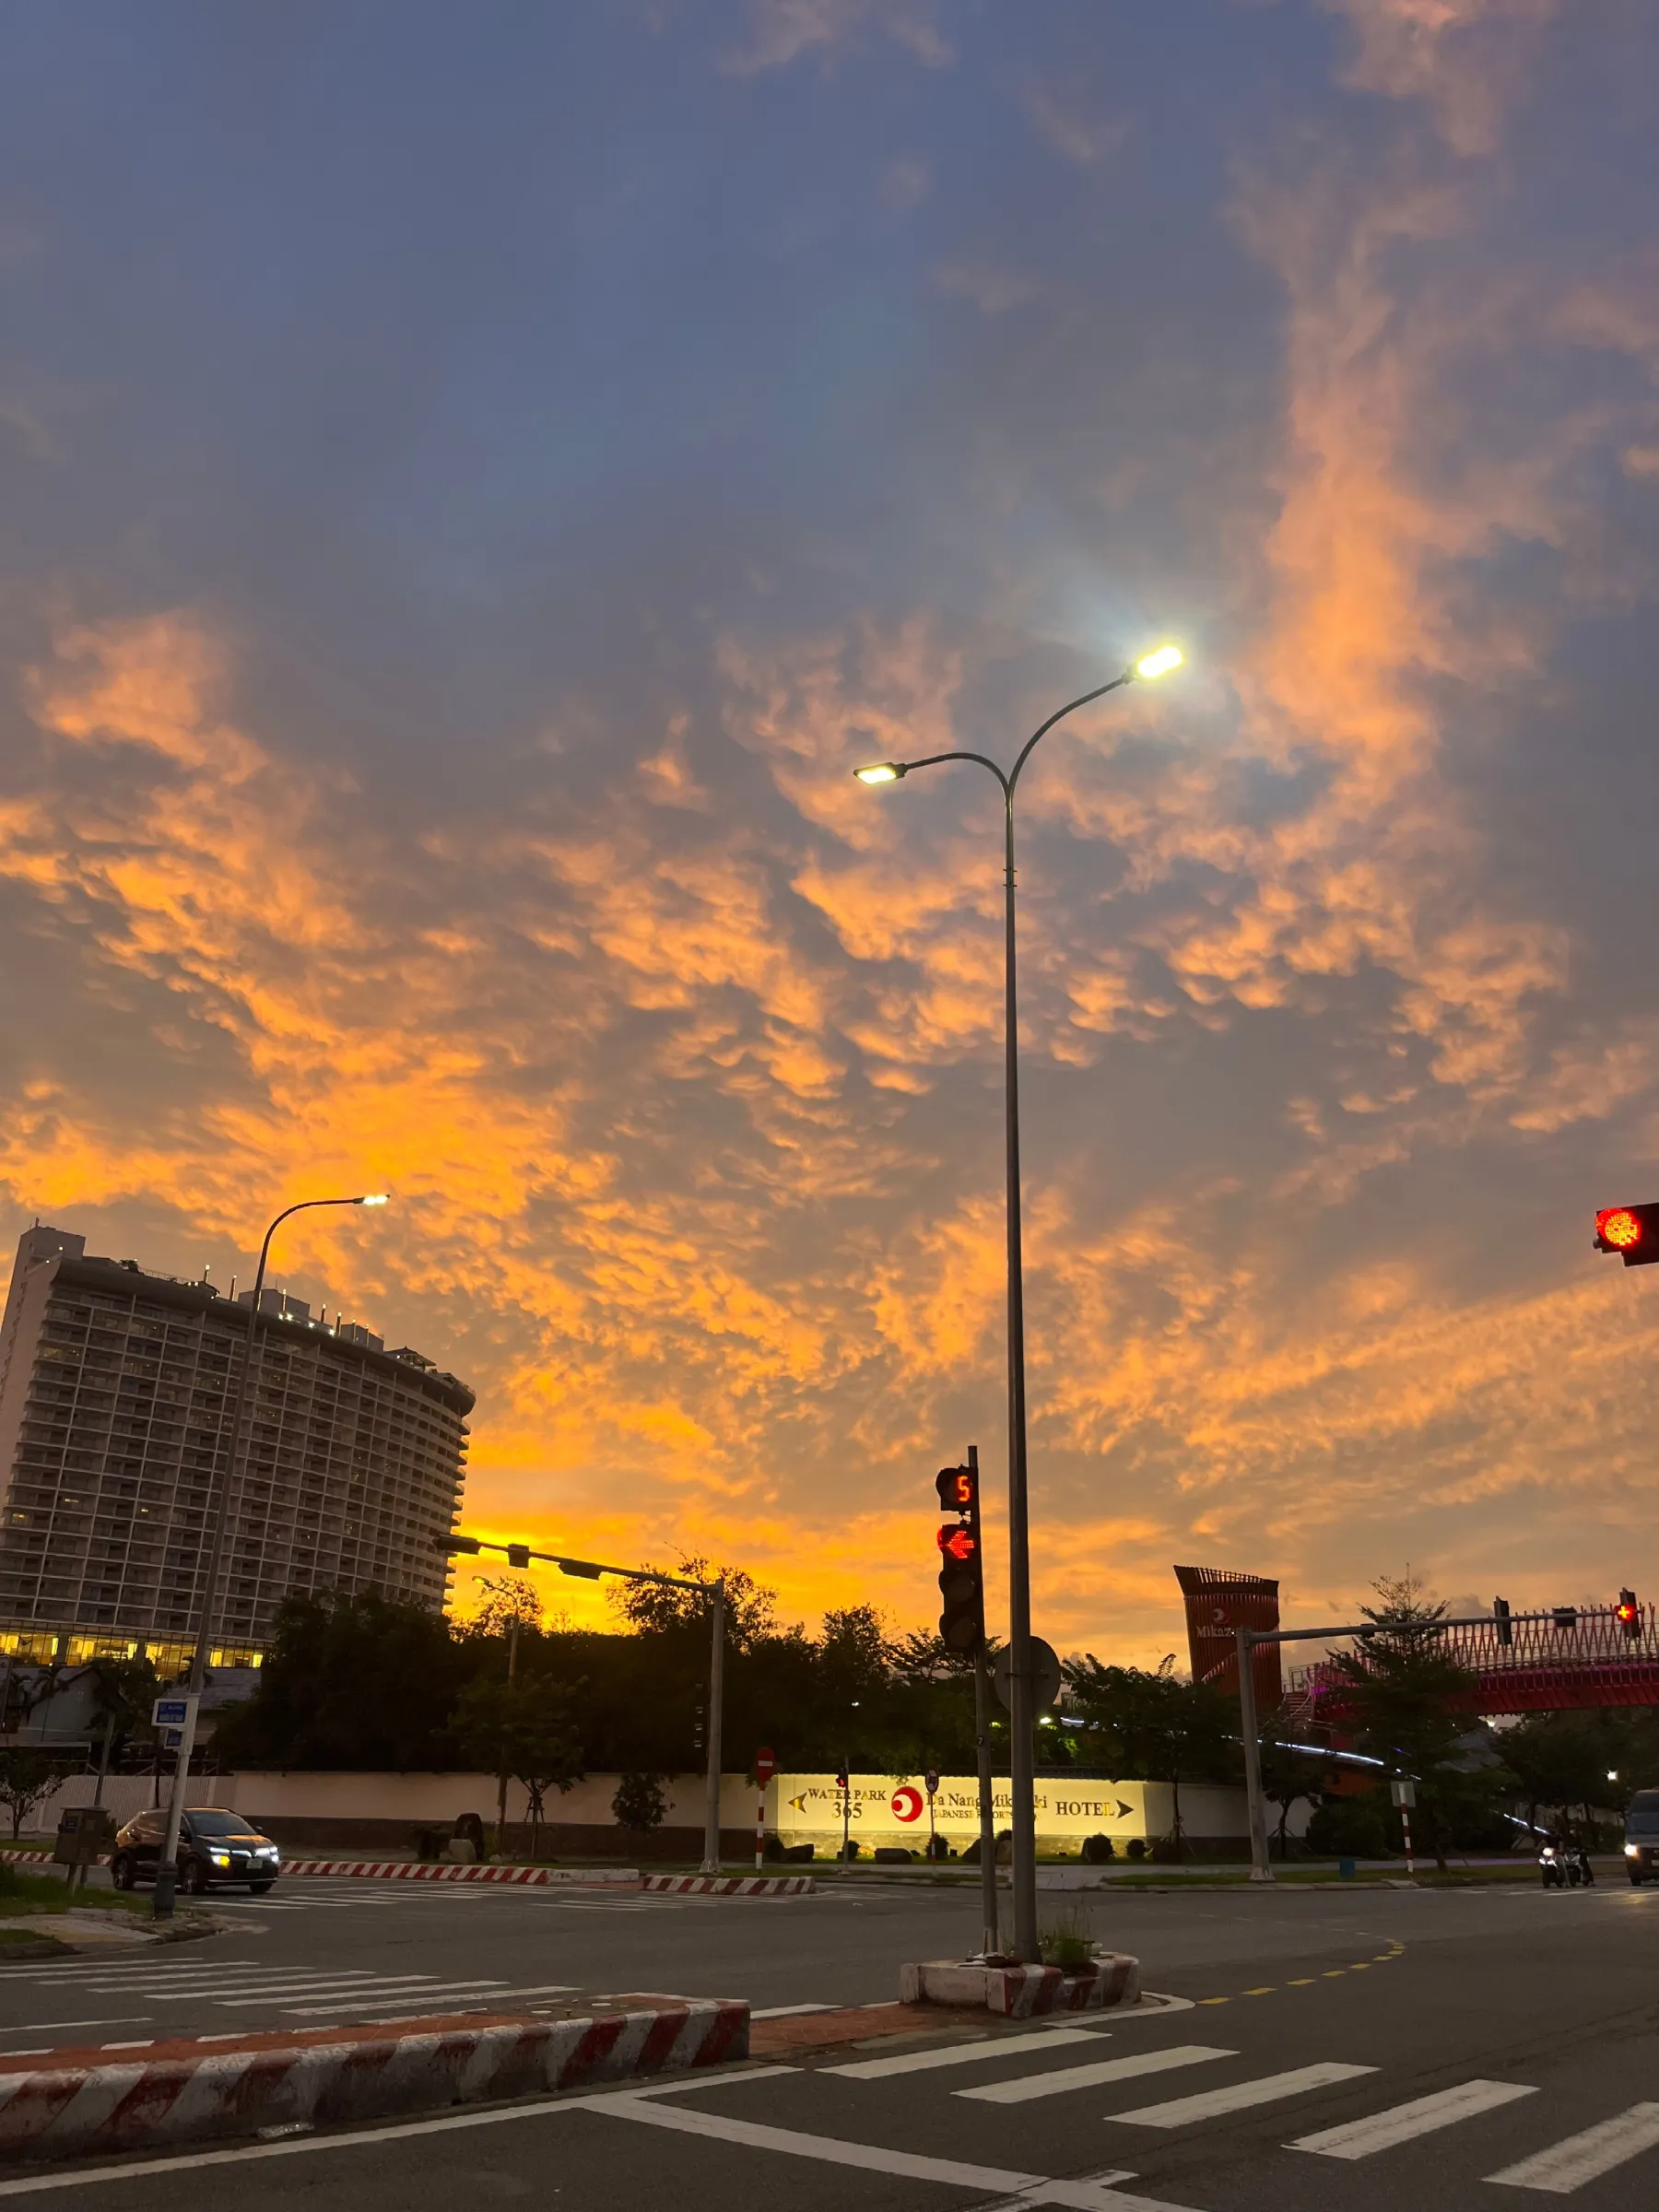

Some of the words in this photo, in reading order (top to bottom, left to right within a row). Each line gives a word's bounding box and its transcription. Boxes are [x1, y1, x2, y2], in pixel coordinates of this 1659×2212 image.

[957, 1476, 971, 1502] 5
[808, 1788, 852, 1800] WATER
[853, 1790, 887, 1801] PARK
[926, 1793, 945, 1806] Da
[832, 1802, 863, 1818] 365
[1055, 1801, 1115, 1817] HOTEL
